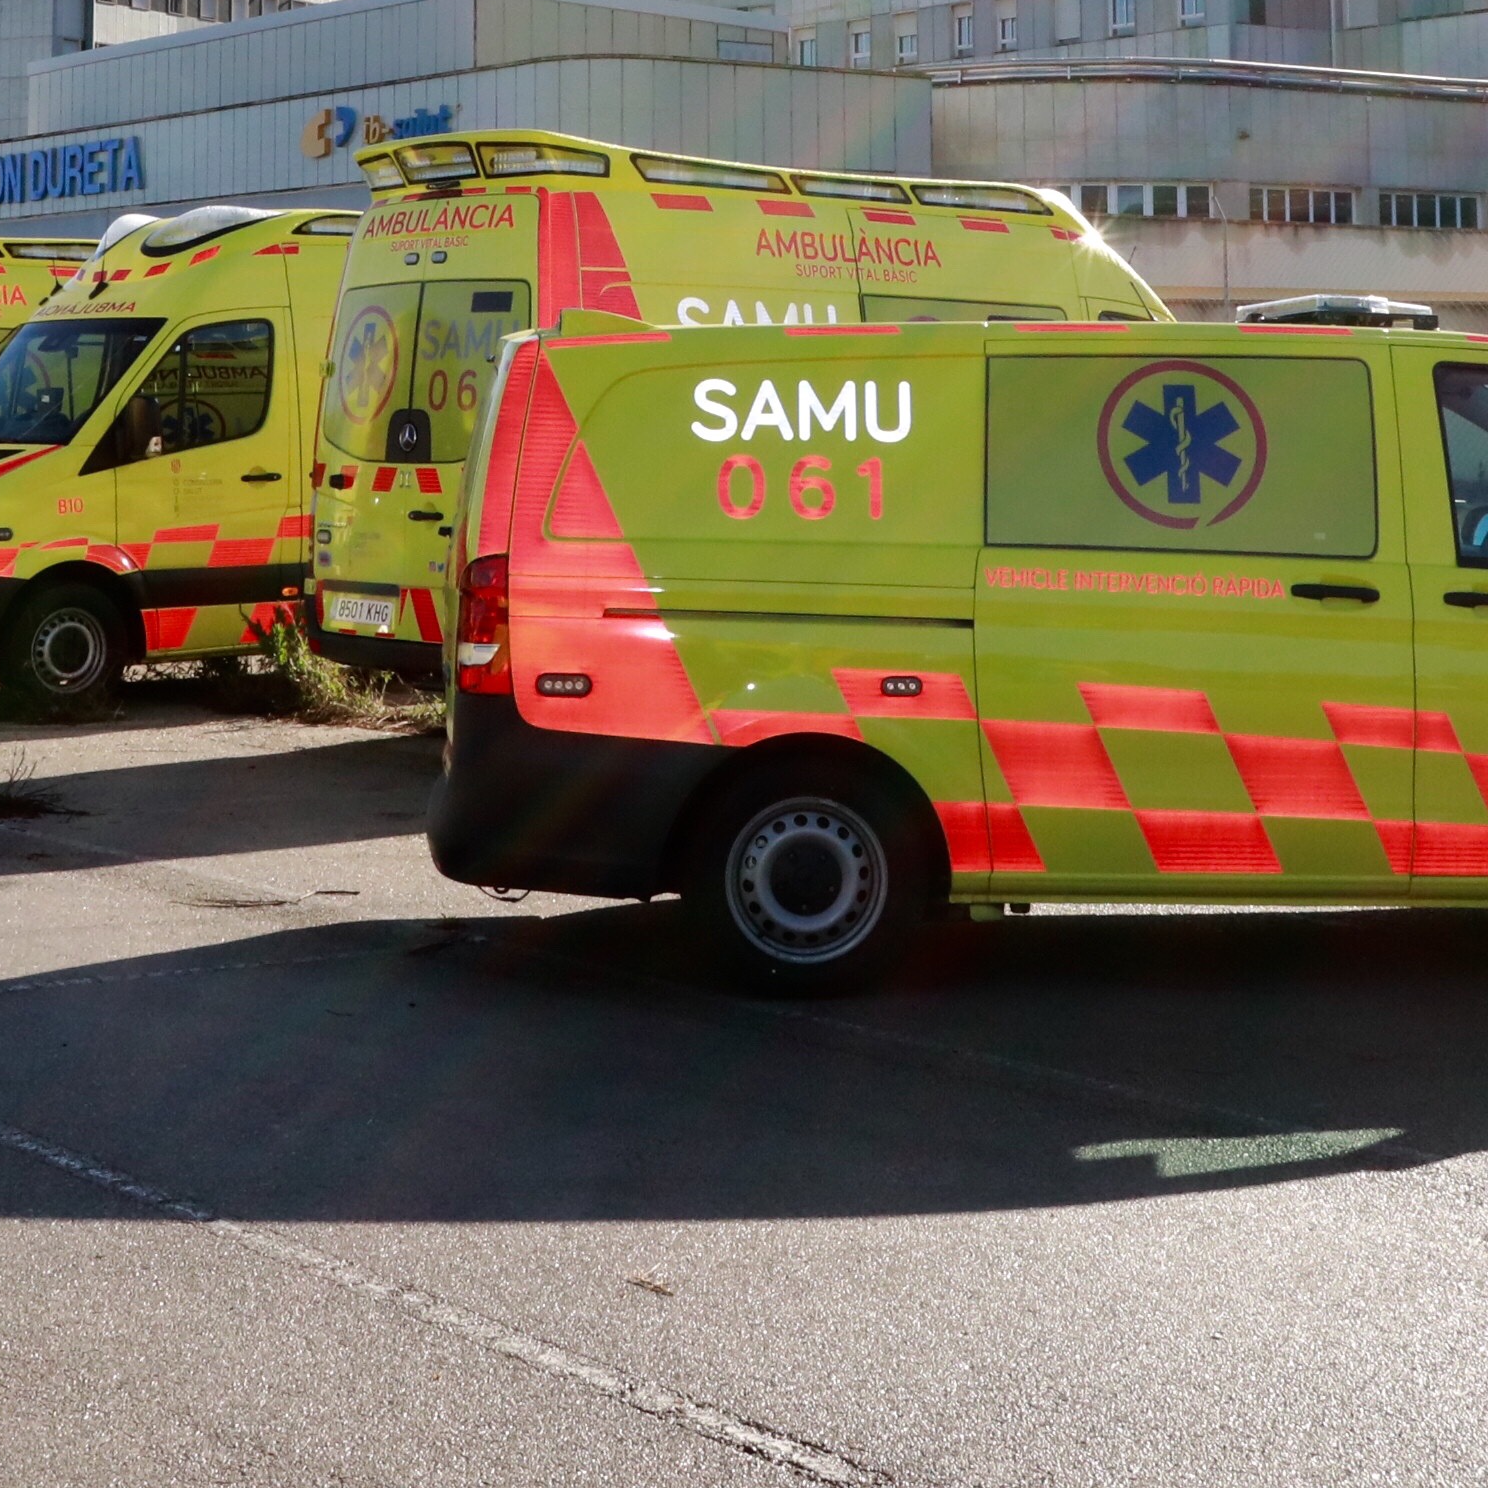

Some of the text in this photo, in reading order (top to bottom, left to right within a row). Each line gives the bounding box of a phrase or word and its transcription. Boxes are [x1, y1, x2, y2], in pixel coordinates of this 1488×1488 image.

[29, 136, 145, 201] DURETA
[362, 201, 515, 239] AMBULÀNCIA
[390, 239, 419, 252] SUPORT
[421, 238, 442, 249] VITAL
[755, 227, 942, 268] AMBULÀNCIA
[795, 264, 842, 279] SUPORT
[847, 267, 880, 281] VITAL
[428, 369, 478, 411] 06
[691, 378, 912, 443] SAMU
[717, 453, 884, 520] 061
[57, 498, 84, 514] B10
[984, 566, 1285, 598] VEHICLE INTERVENCIÓ RÀPIDA
[338, 600, 389, 622] 8501 KHG
